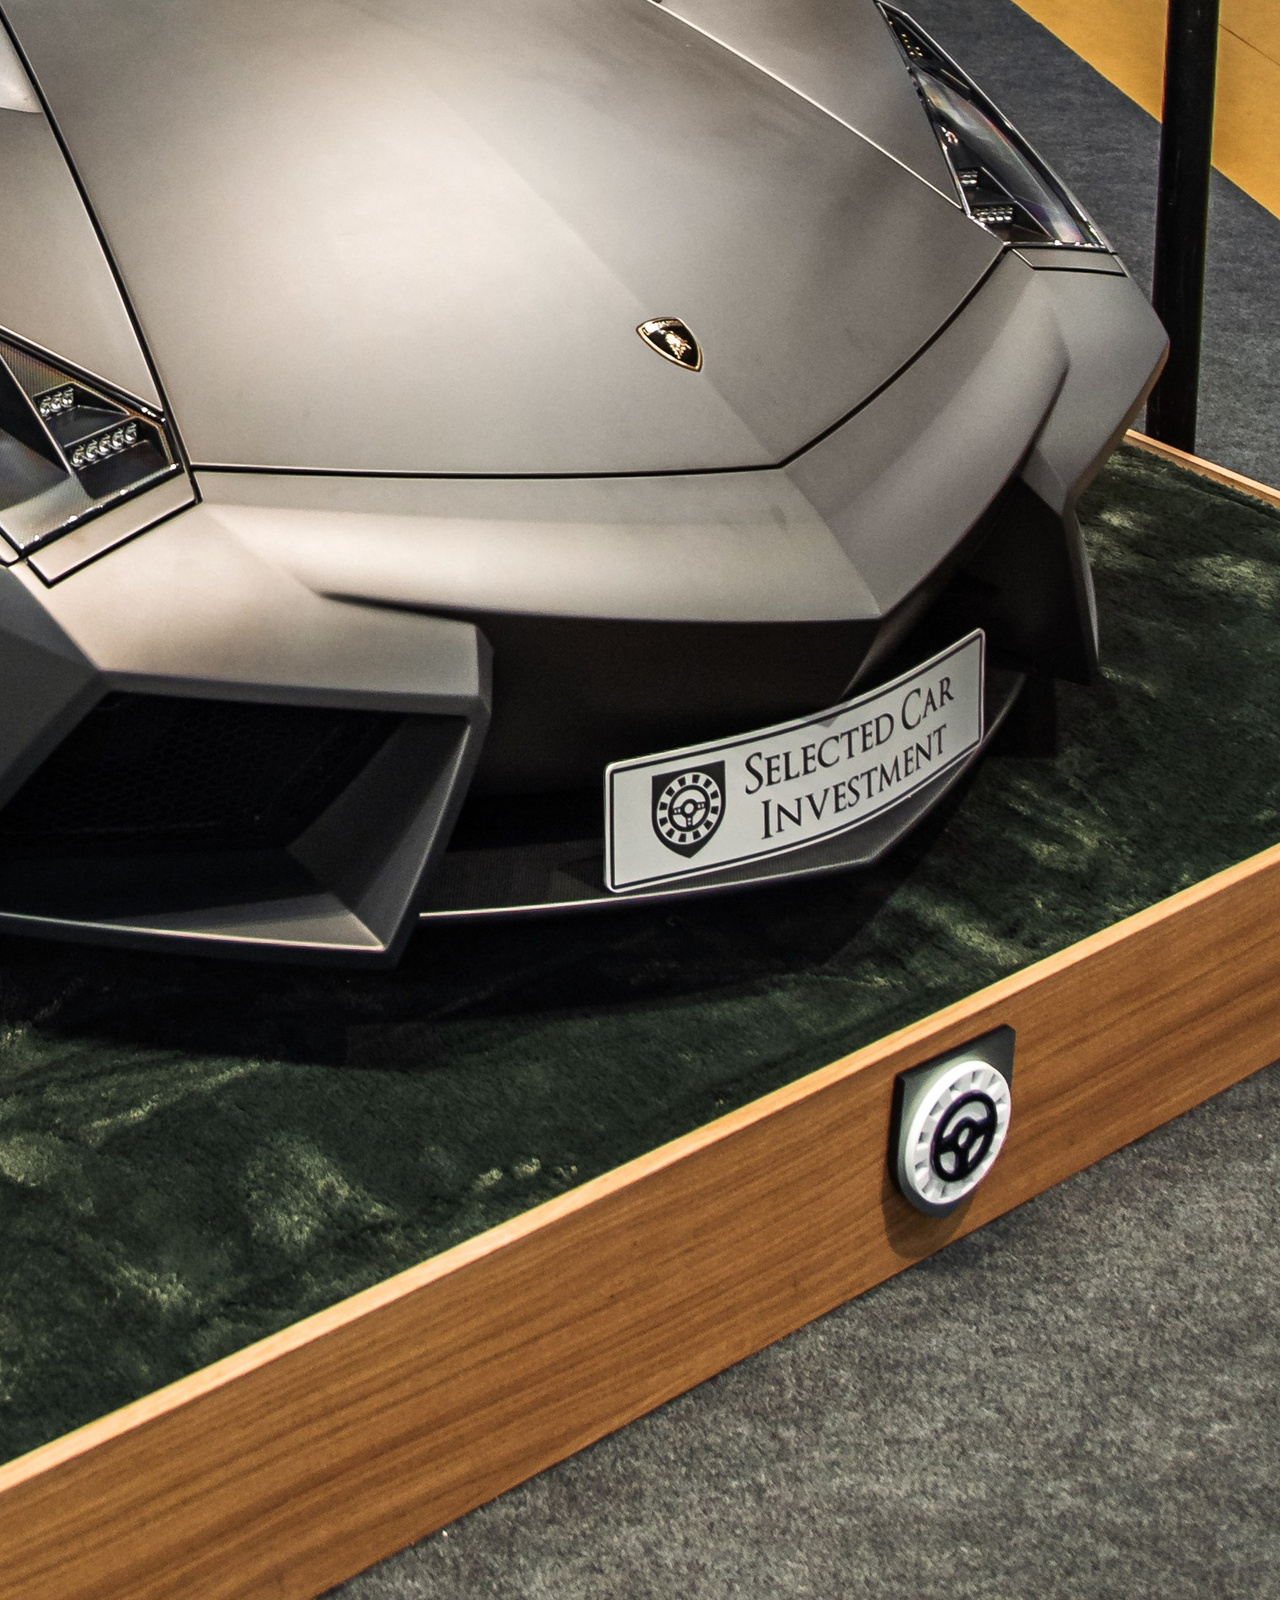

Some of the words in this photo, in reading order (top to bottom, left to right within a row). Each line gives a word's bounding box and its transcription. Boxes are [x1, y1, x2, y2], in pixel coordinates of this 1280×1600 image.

[745, 713, 894, 795] SELECTED
[901, 676, 955, 730] CAR
[761, 724, 947, 840] INVESTMENT
